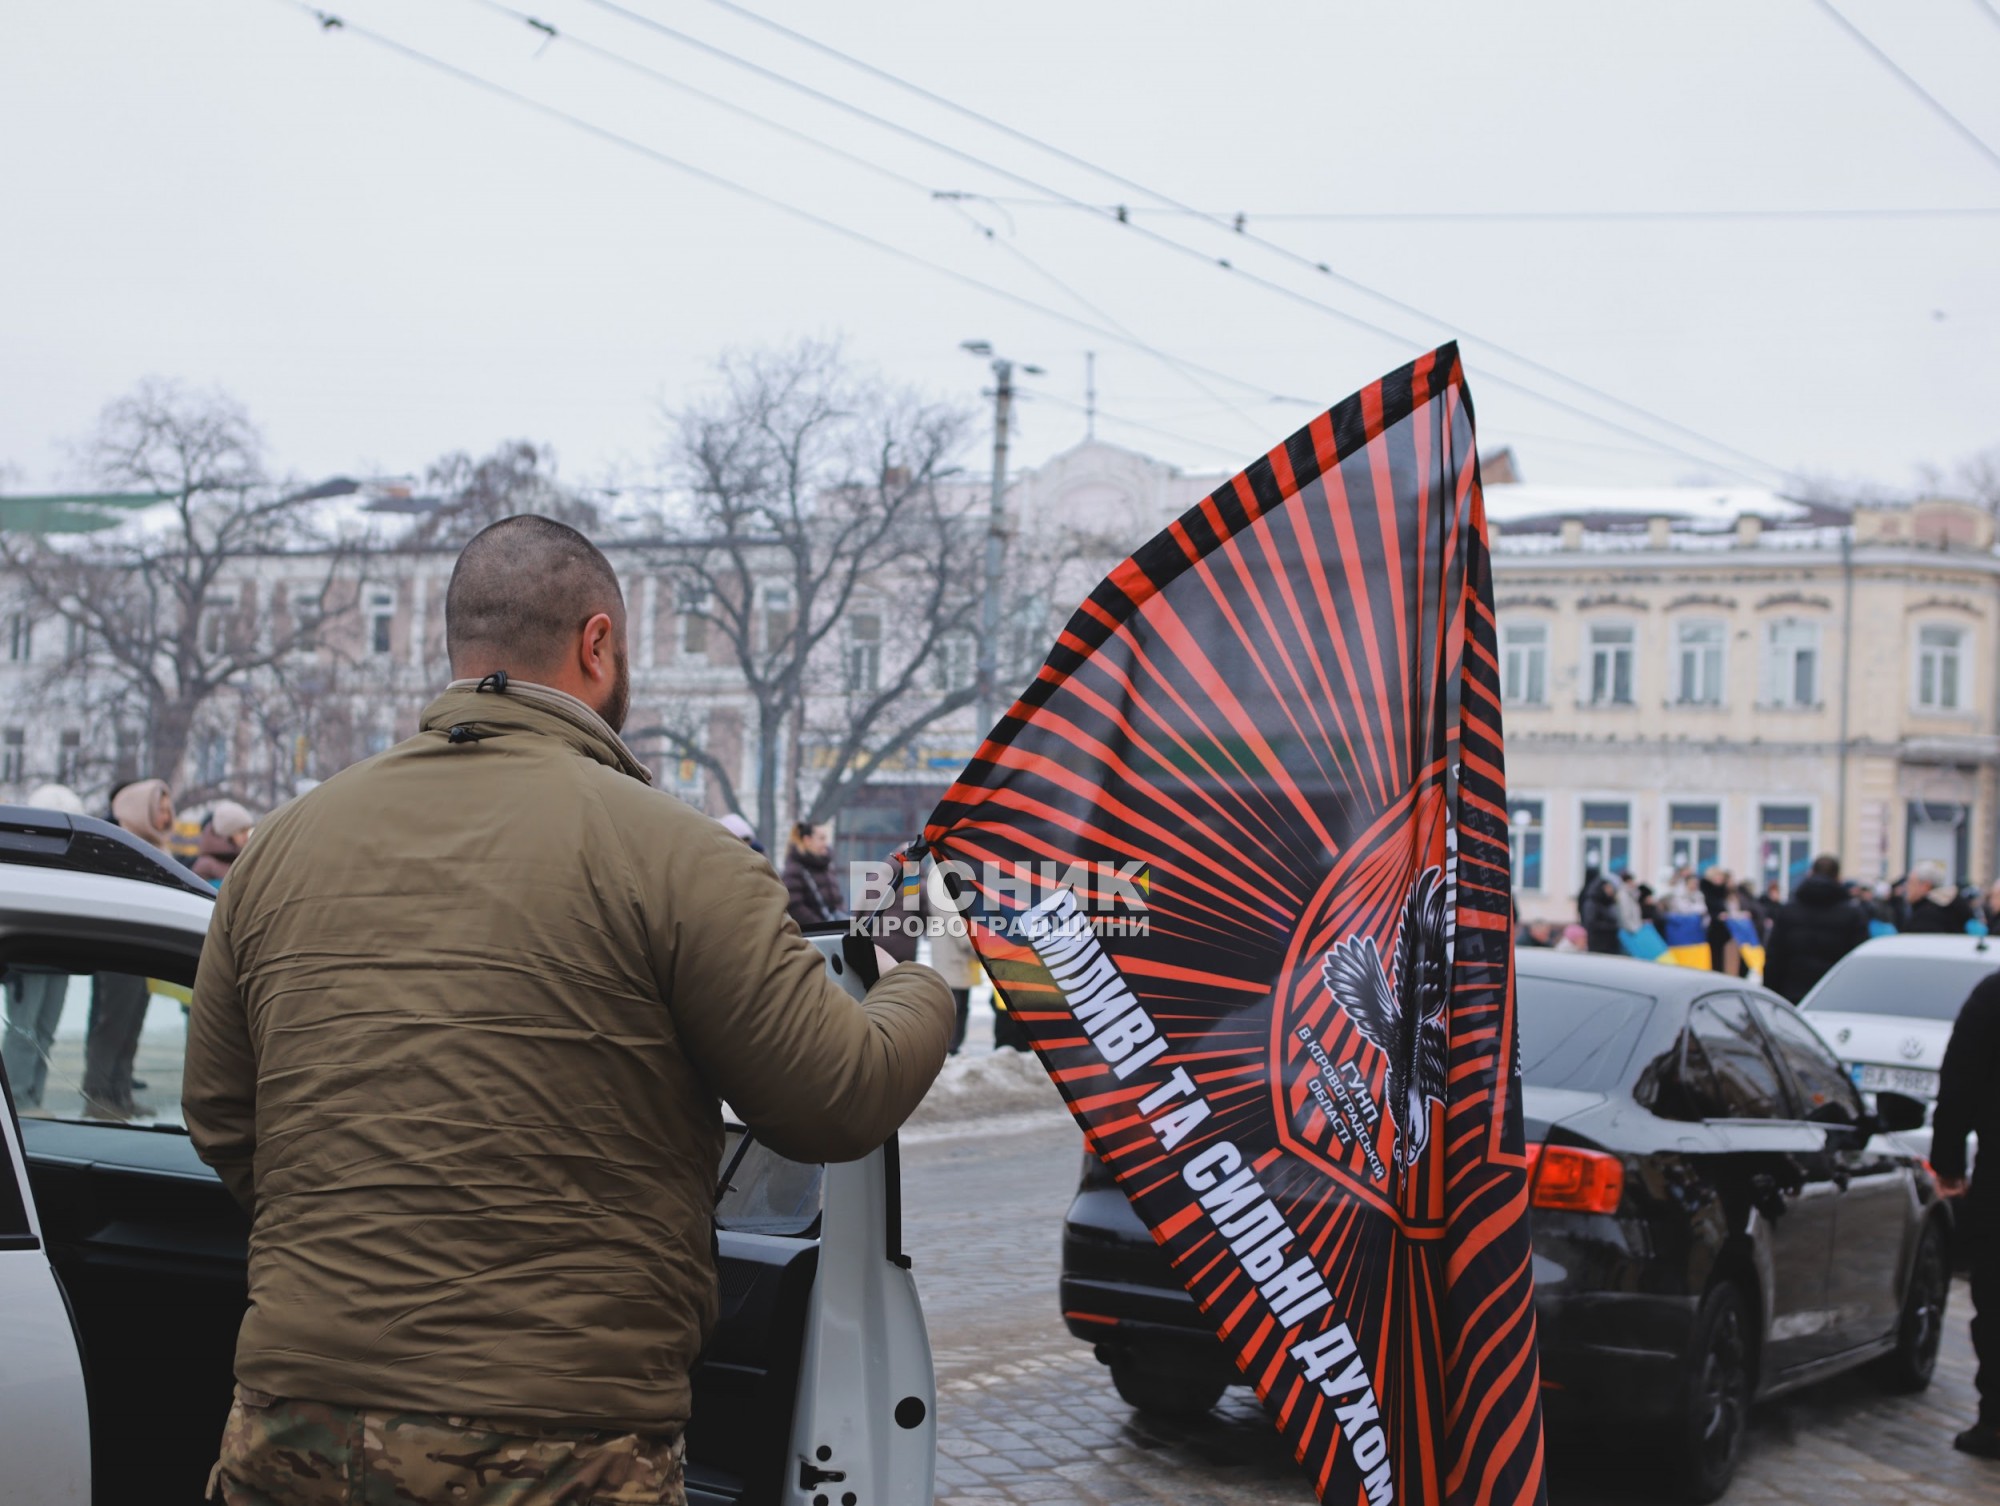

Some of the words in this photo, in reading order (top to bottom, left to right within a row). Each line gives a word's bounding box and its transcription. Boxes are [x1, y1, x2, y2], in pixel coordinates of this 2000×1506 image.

[1298, 1026, 1312, 1040] В
[1307, 1039, 1385, 1180] КІРОВОГРАДСЬКІЙ
[1308, 1078, 1352, 1146] ОБЛАСТІ
[1340, 1060, 1380, 1125] ГУНП
[1137, 1065, 1212, 1152] ТА
[1182, 1140, 1335, 1330] СИЛЬНІ
[1289, 1321, 1394, 1506] ДУХОМ
